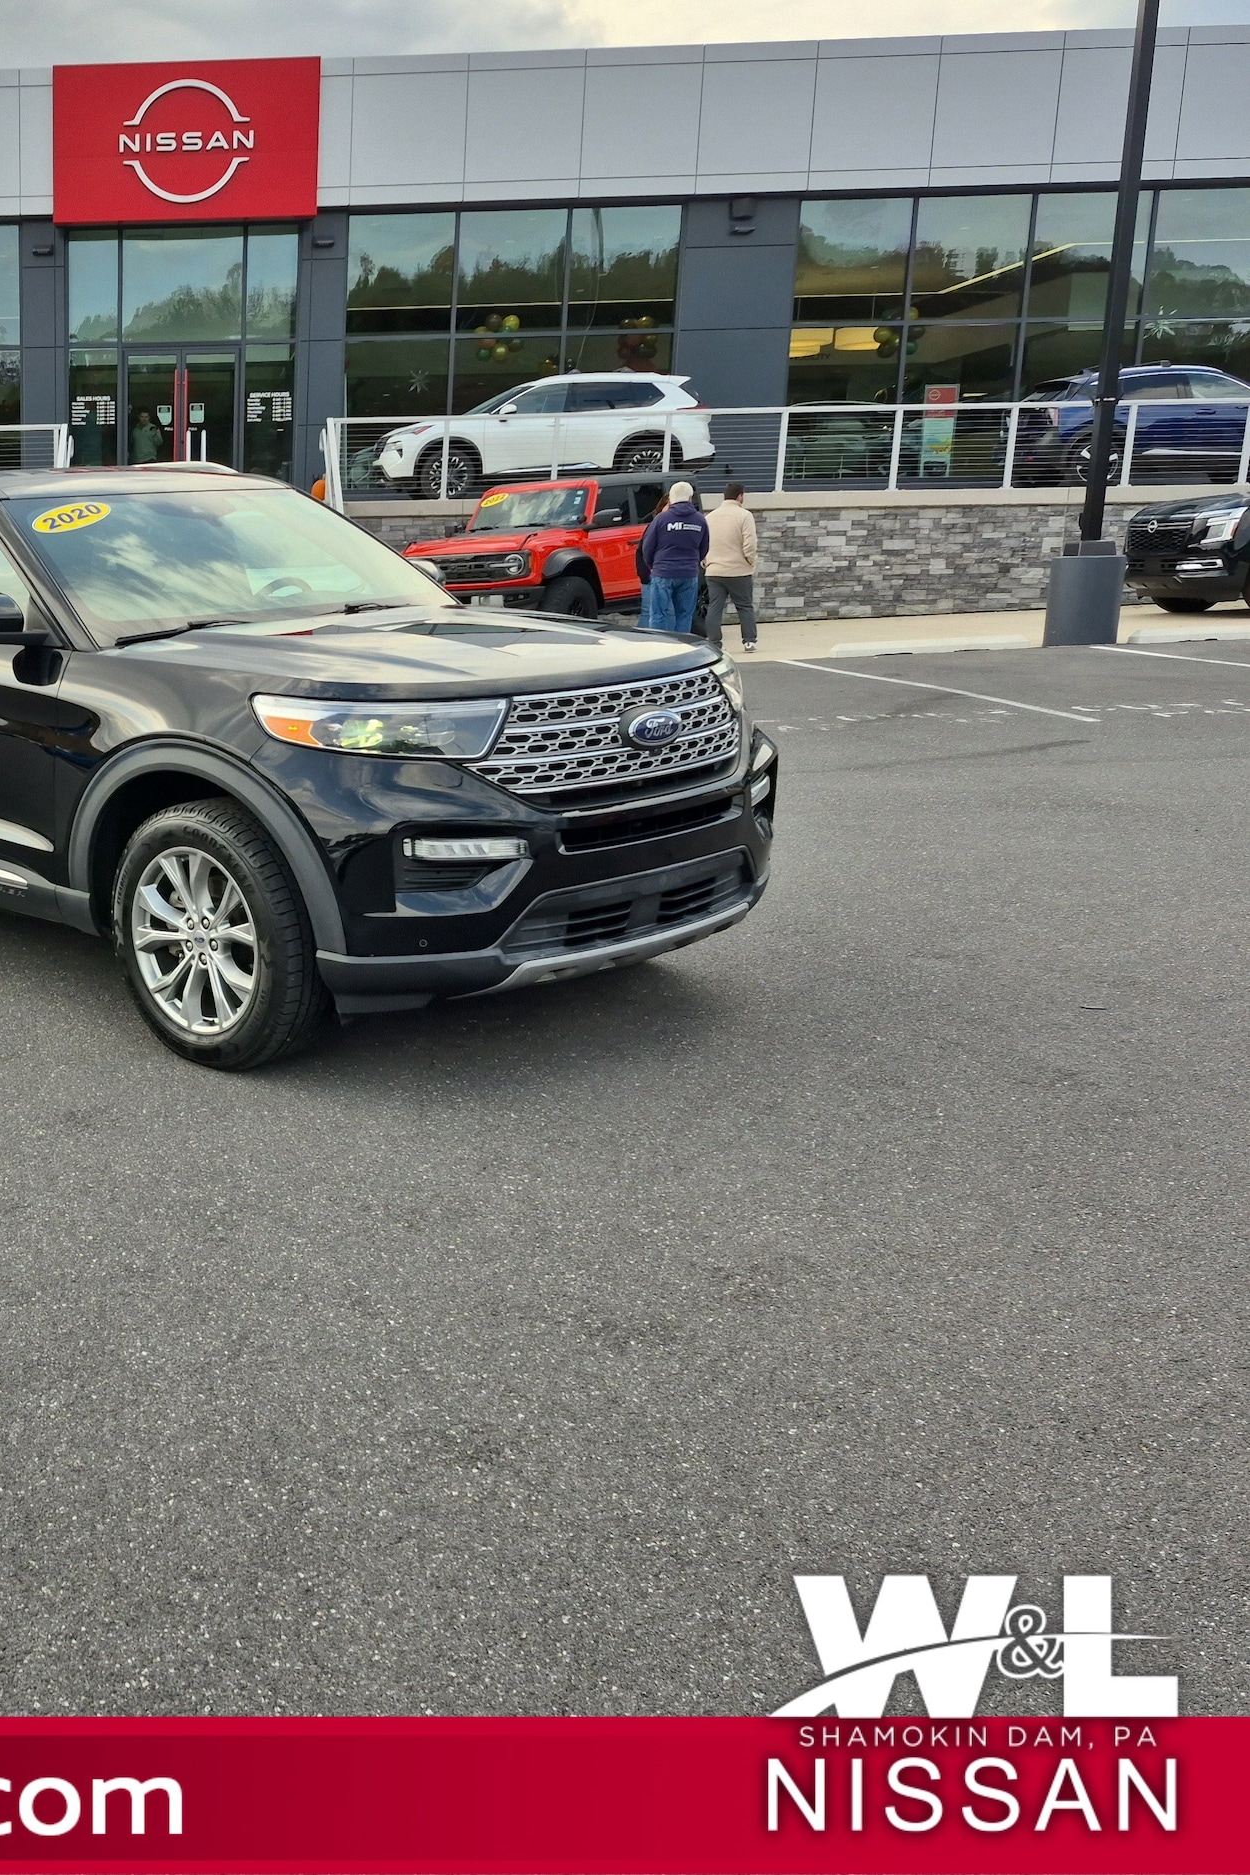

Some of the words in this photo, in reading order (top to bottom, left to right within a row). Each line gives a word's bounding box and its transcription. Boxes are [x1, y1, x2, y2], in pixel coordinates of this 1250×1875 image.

[119, 129, 255, 153] NISSAN
[42, 504, 101, 530] 2020
[645, 717, 673, 738] Ford
